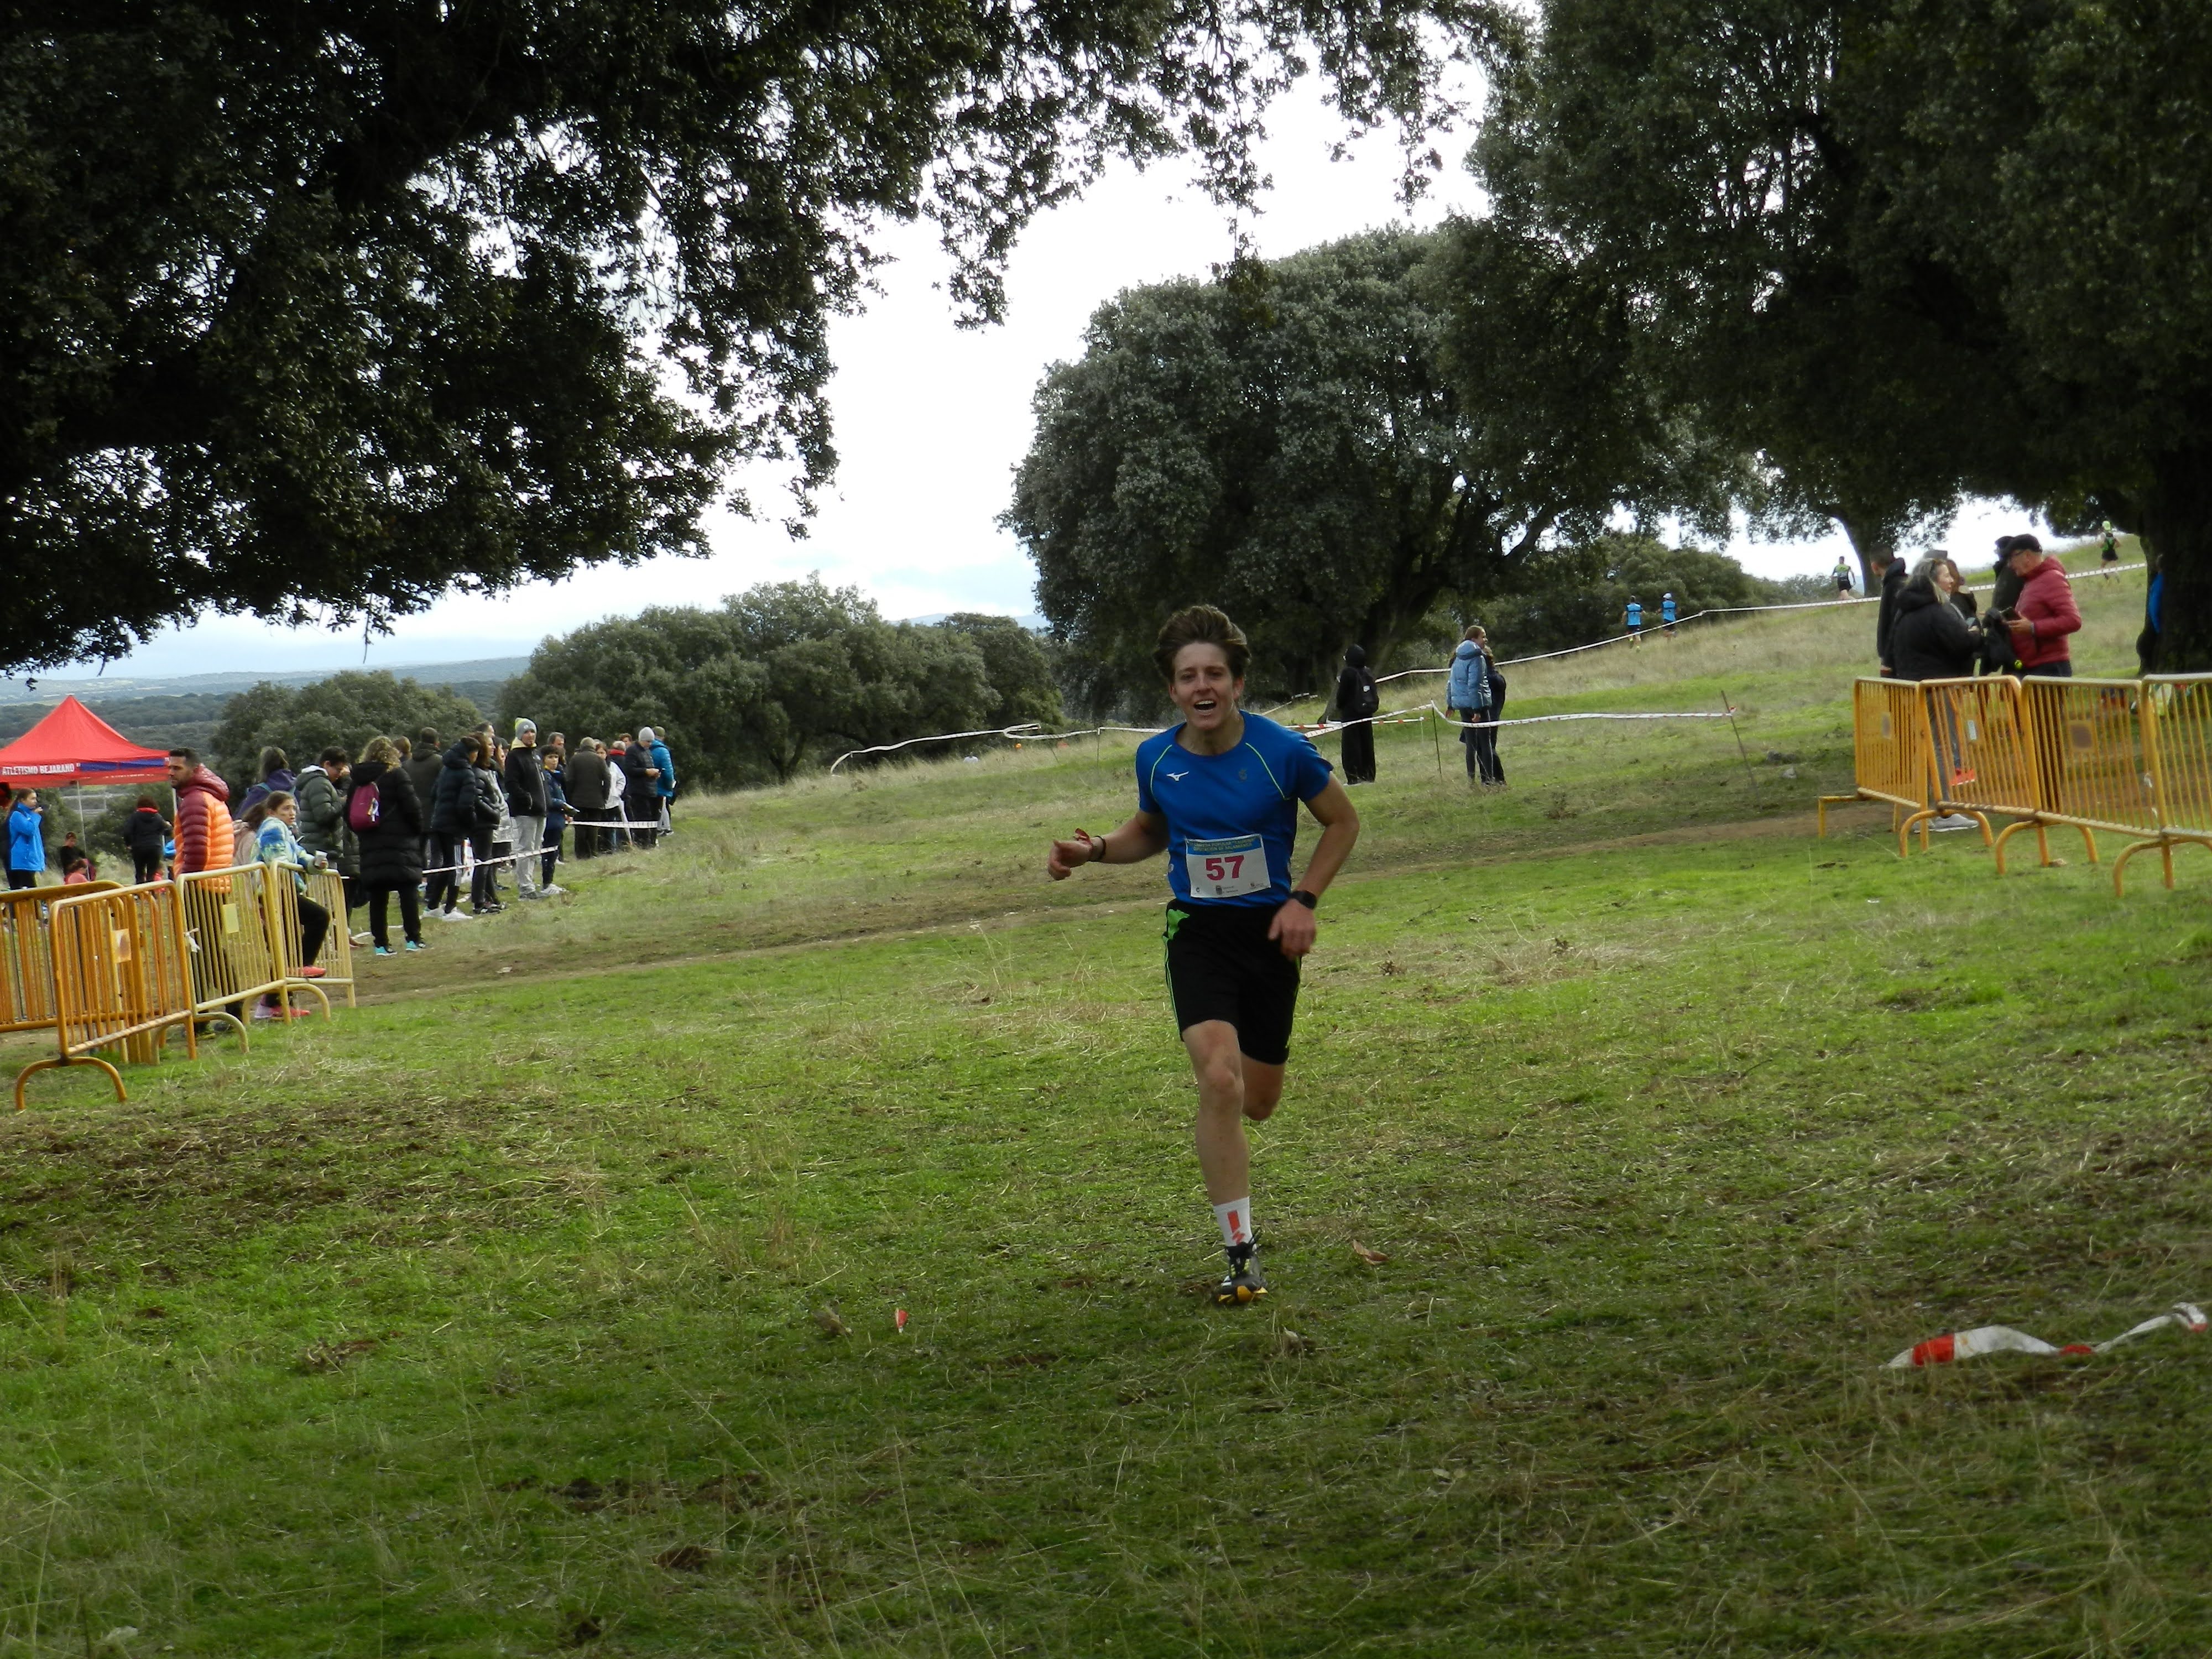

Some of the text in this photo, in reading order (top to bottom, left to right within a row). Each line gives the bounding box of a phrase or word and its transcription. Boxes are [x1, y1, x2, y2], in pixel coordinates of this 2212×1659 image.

[2, 763, 75, 775] ATLETISMO BEJARANO
[1206, 855, 1244, 881] 57
